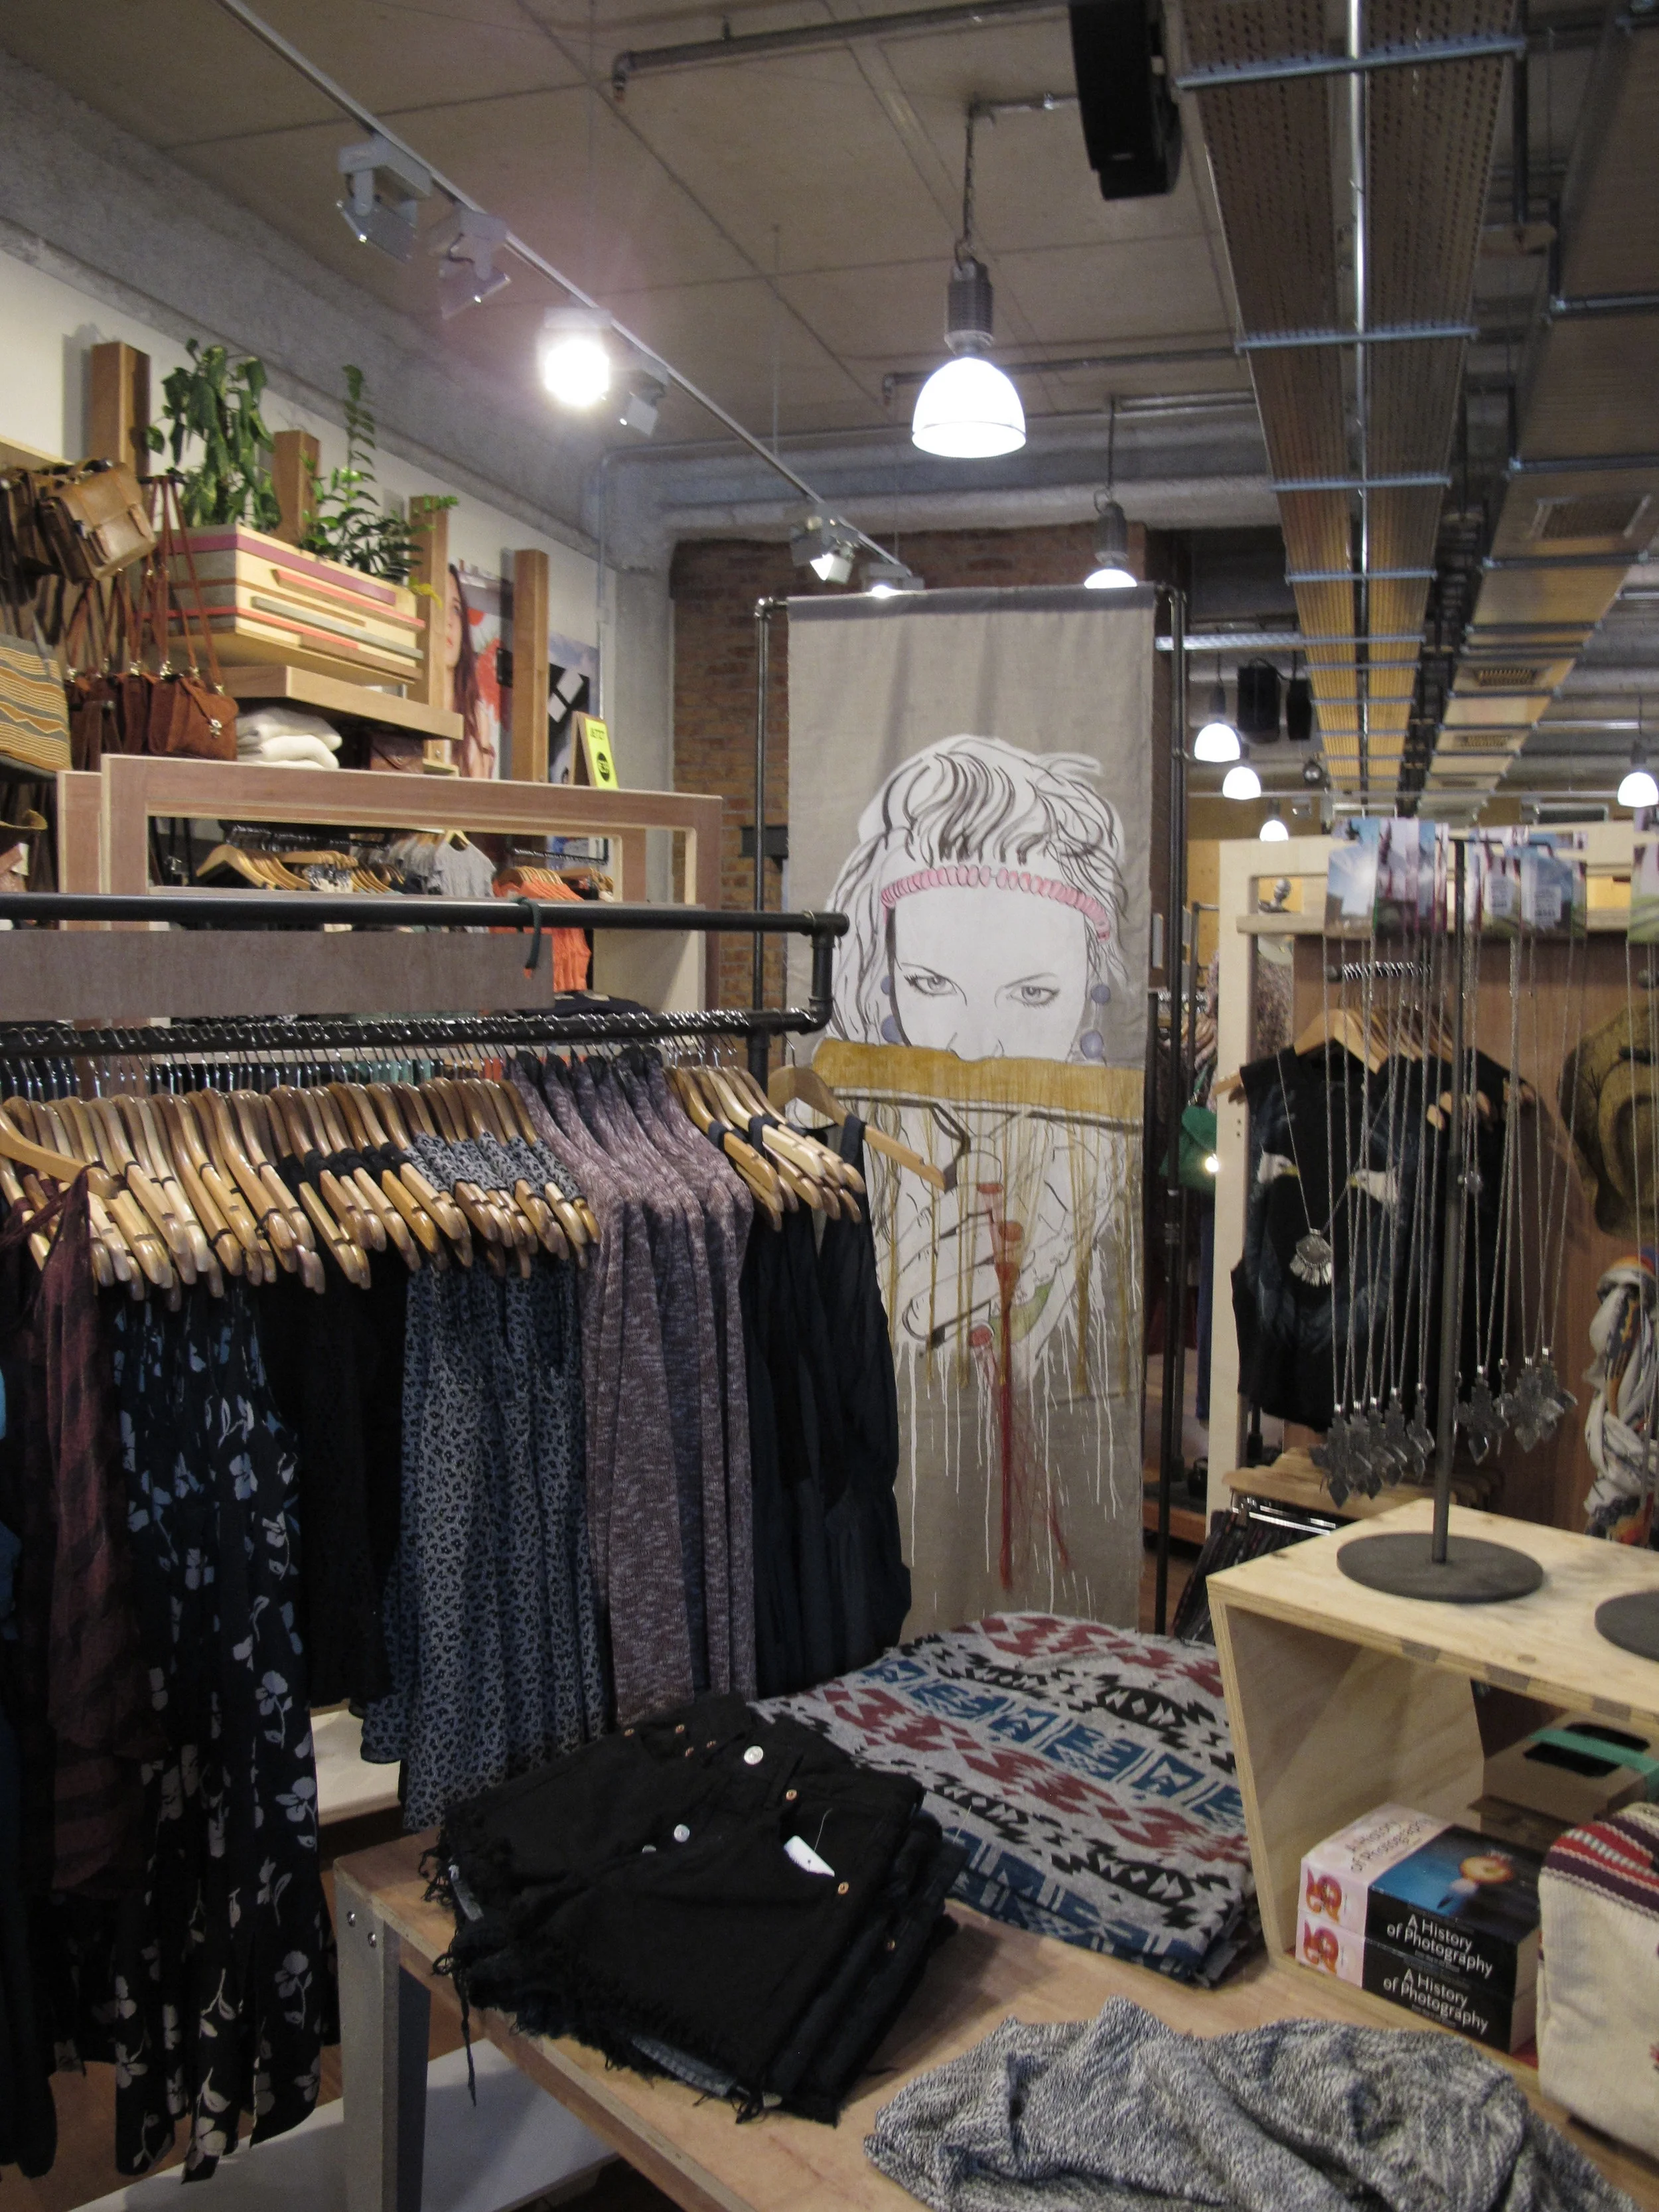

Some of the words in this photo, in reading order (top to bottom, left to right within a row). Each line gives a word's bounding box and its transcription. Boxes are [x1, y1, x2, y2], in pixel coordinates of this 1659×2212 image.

[1386, 1922, 1403, 1939] of
[1404, 1926, 1493, 1980] Photography
[1407, 1913, 1418, 1929] A
[1421, 1918, 1473, 1954] History
[1383, 1976, 1399, 1992] of
[1401, 1980, 1488, 2035] Photography
[1404, 1968, 1414, 1982] A
[1417, 1972, 1469, 2010] History
